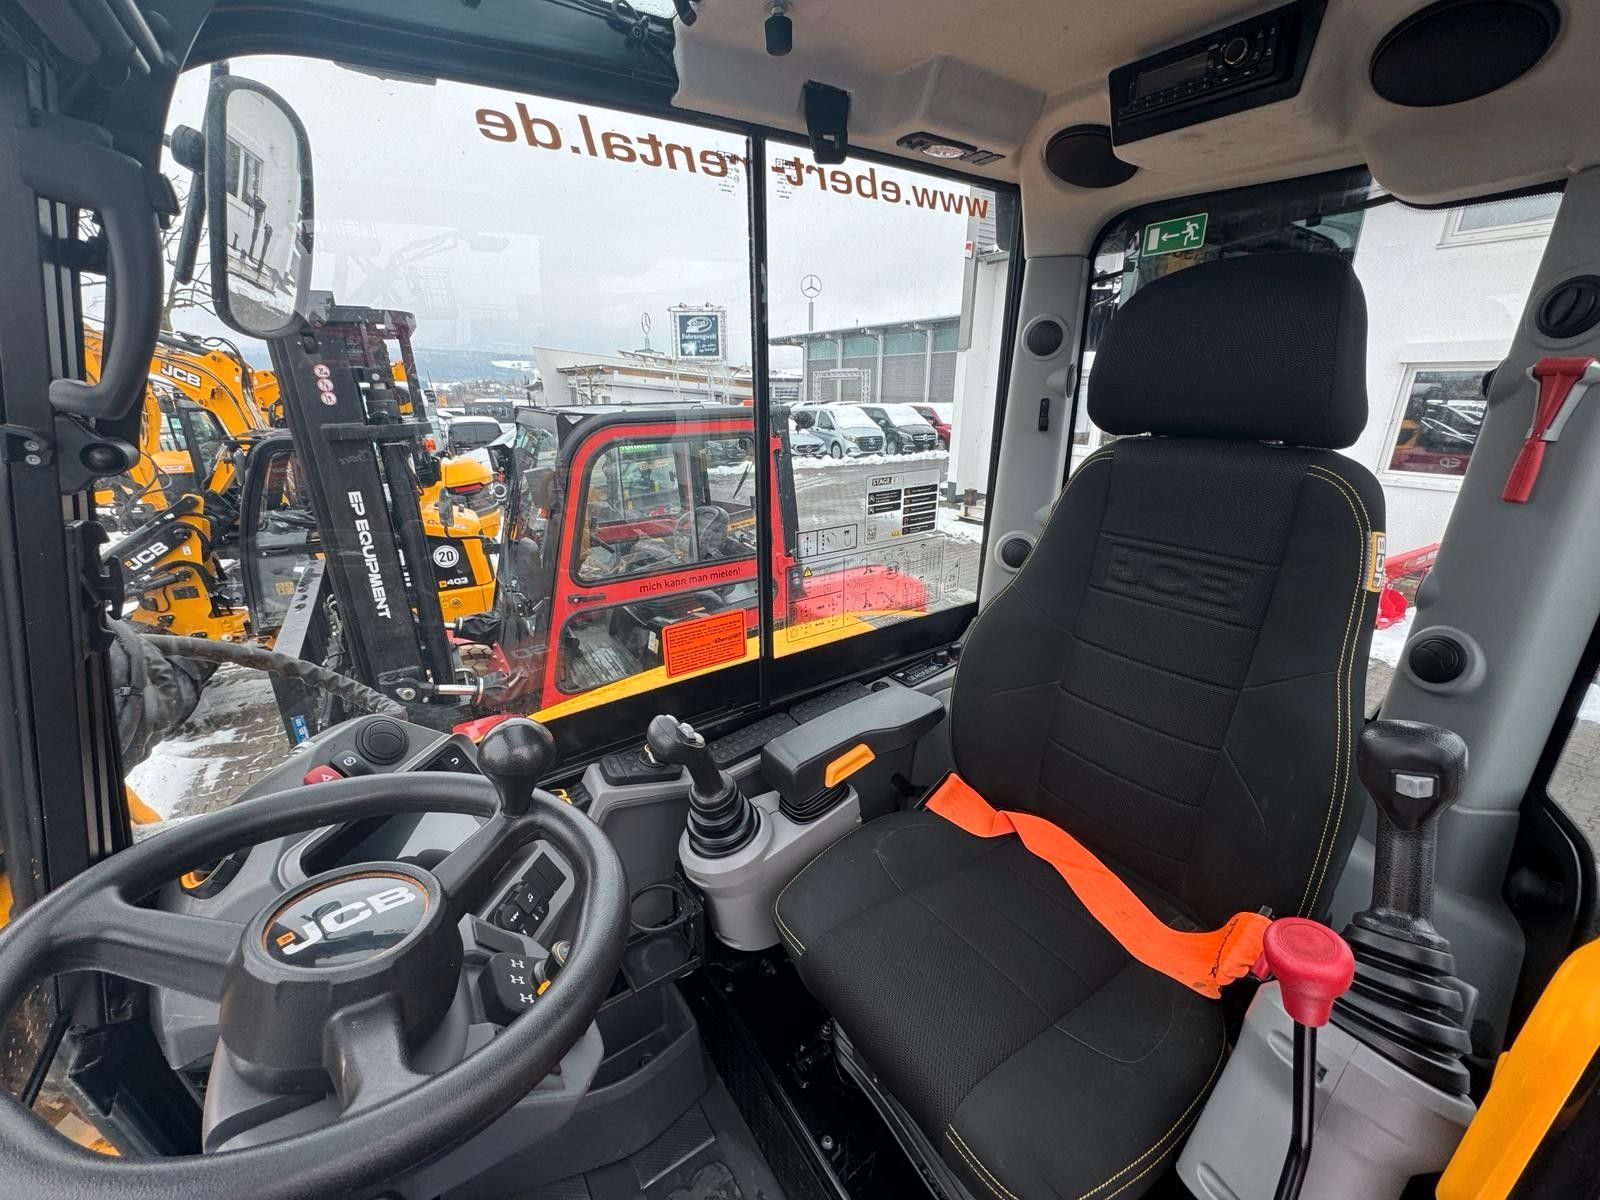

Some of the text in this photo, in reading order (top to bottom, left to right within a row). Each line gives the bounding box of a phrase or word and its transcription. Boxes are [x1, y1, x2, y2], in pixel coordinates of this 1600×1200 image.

[161, 362, 201, 388] JCB
[348, 491, 366, 516] EP
[128, 541, 169, 571] JCB
[354, 519, 392, 619] EQUIPMENT
[438, 550, 455, 563] 20
[1373, 536, 1386, 589] JCB
[447, 577, 469, 586] 403
[640, 567, 741, 593] mich kann man mieten!
[280, 886, 416, 955] JCB
